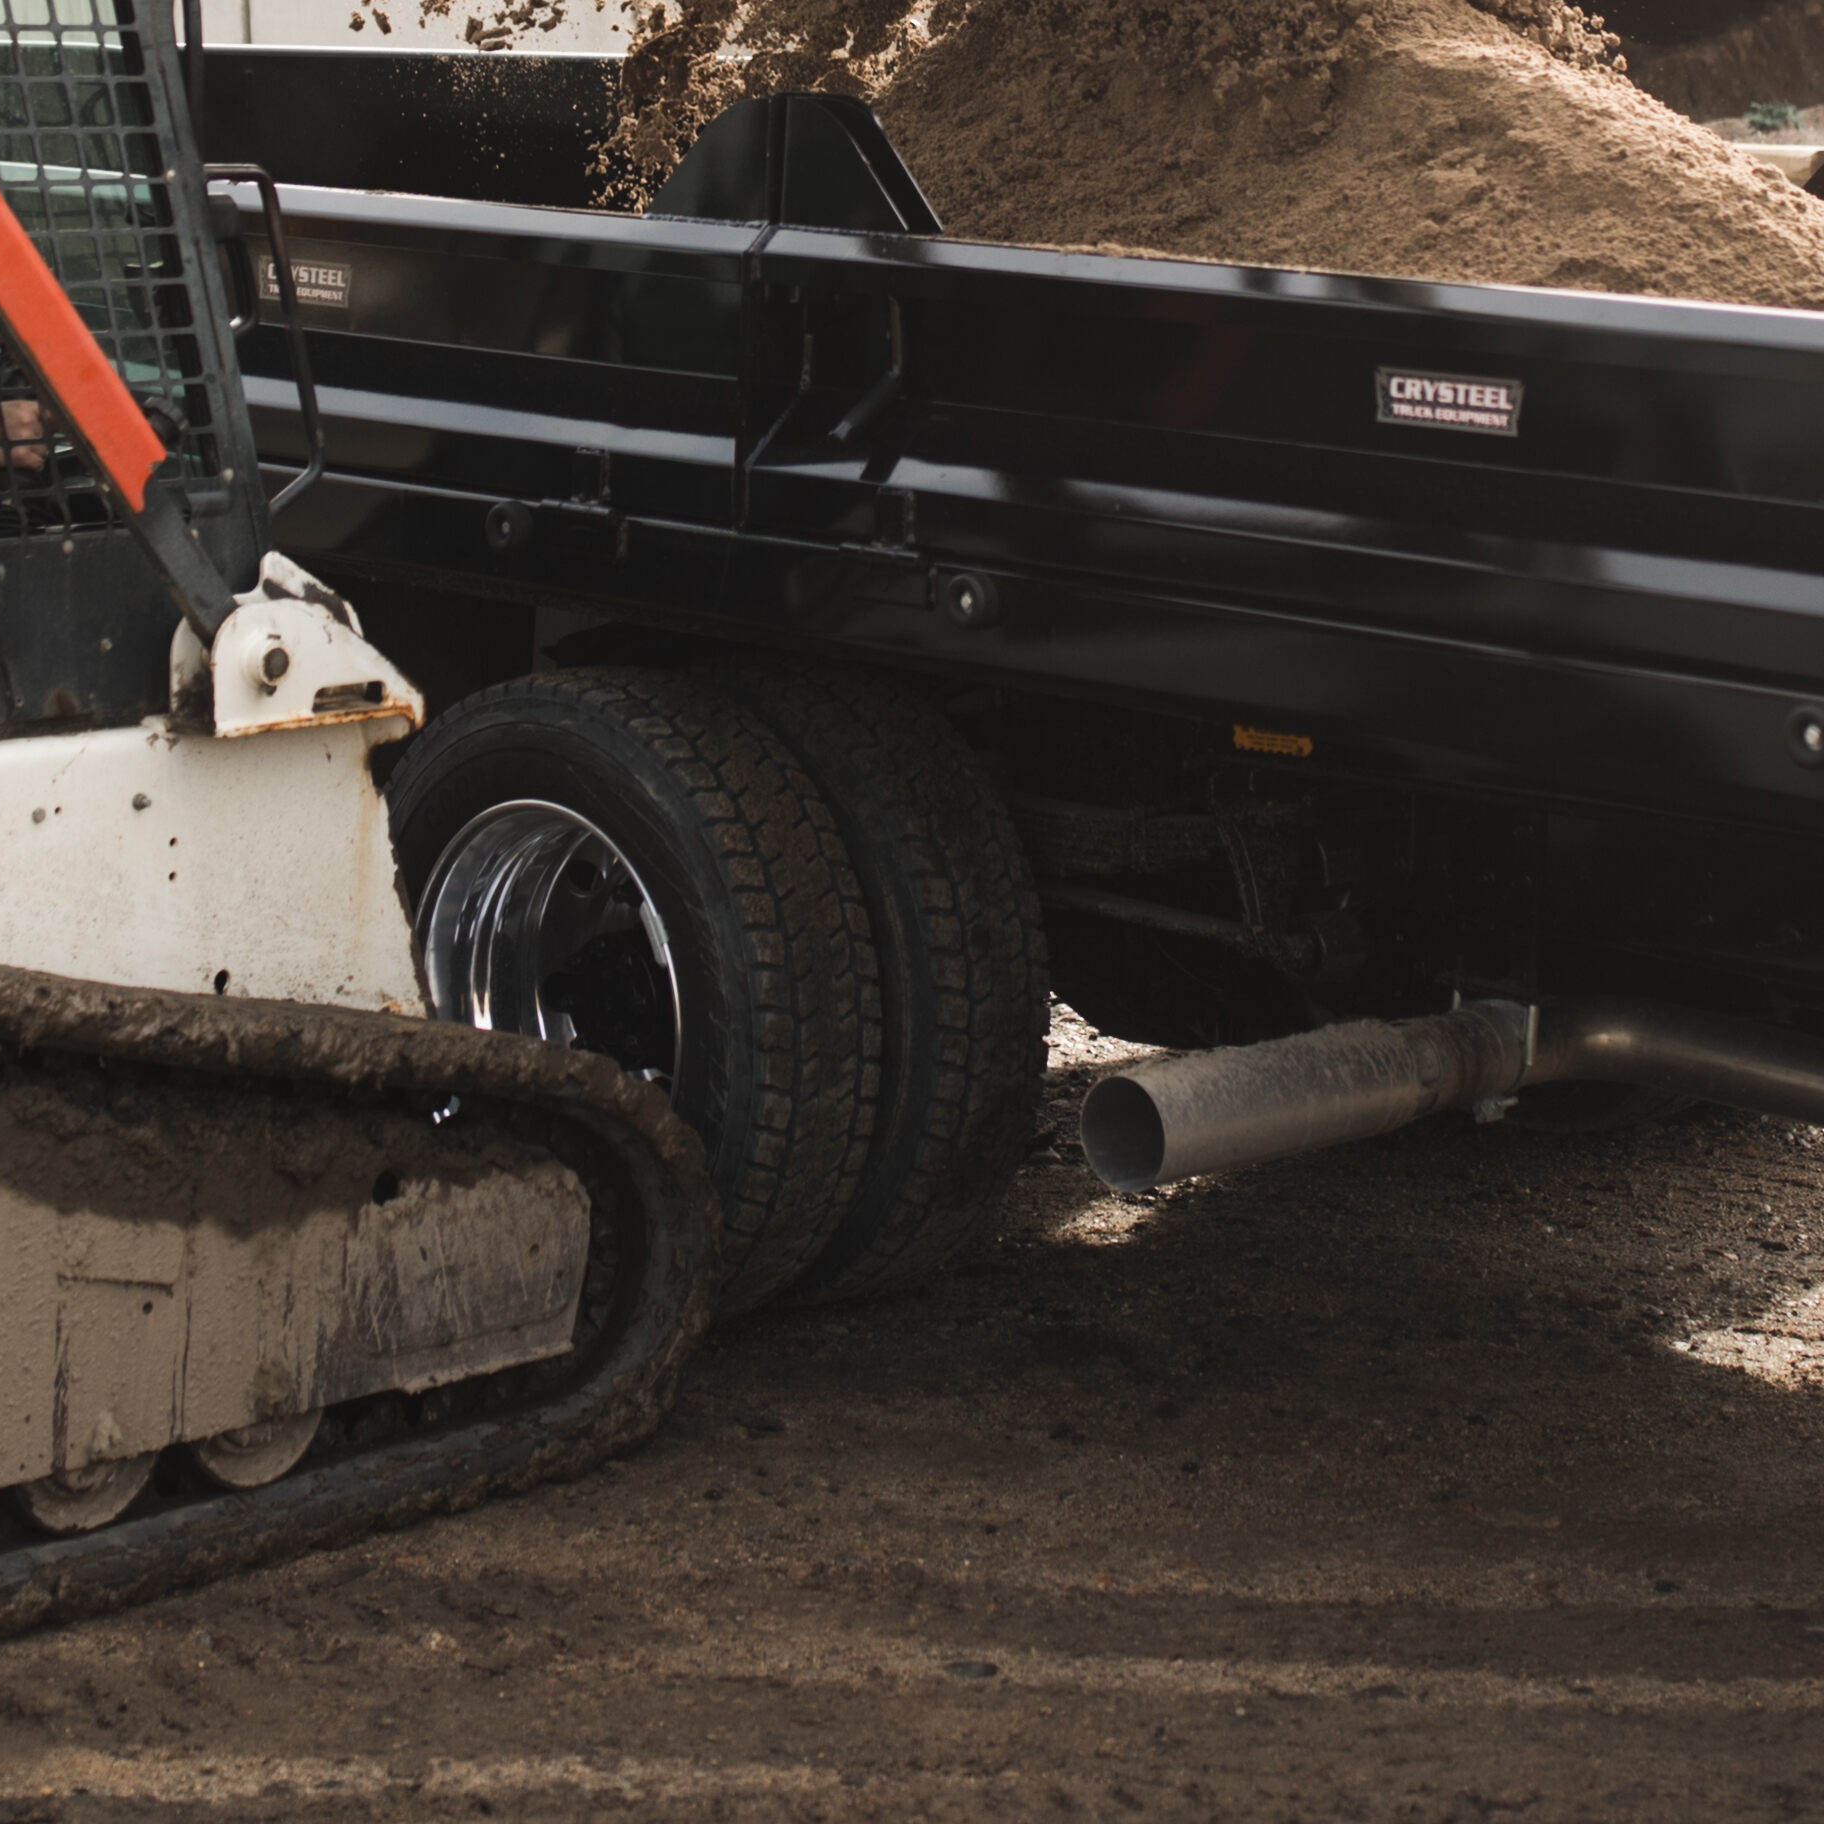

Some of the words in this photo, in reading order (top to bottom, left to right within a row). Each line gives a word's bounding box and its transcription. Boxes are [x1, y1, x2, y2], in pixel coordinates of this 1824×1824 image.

[267, 263, 346, 288] CYSTEEL
[1389, 376, 1514, 410] CRYSTEEL
[1392, 403, 1434, 420] TRUCK
[1435, 407, 1510, 428] EQUIPMENT
